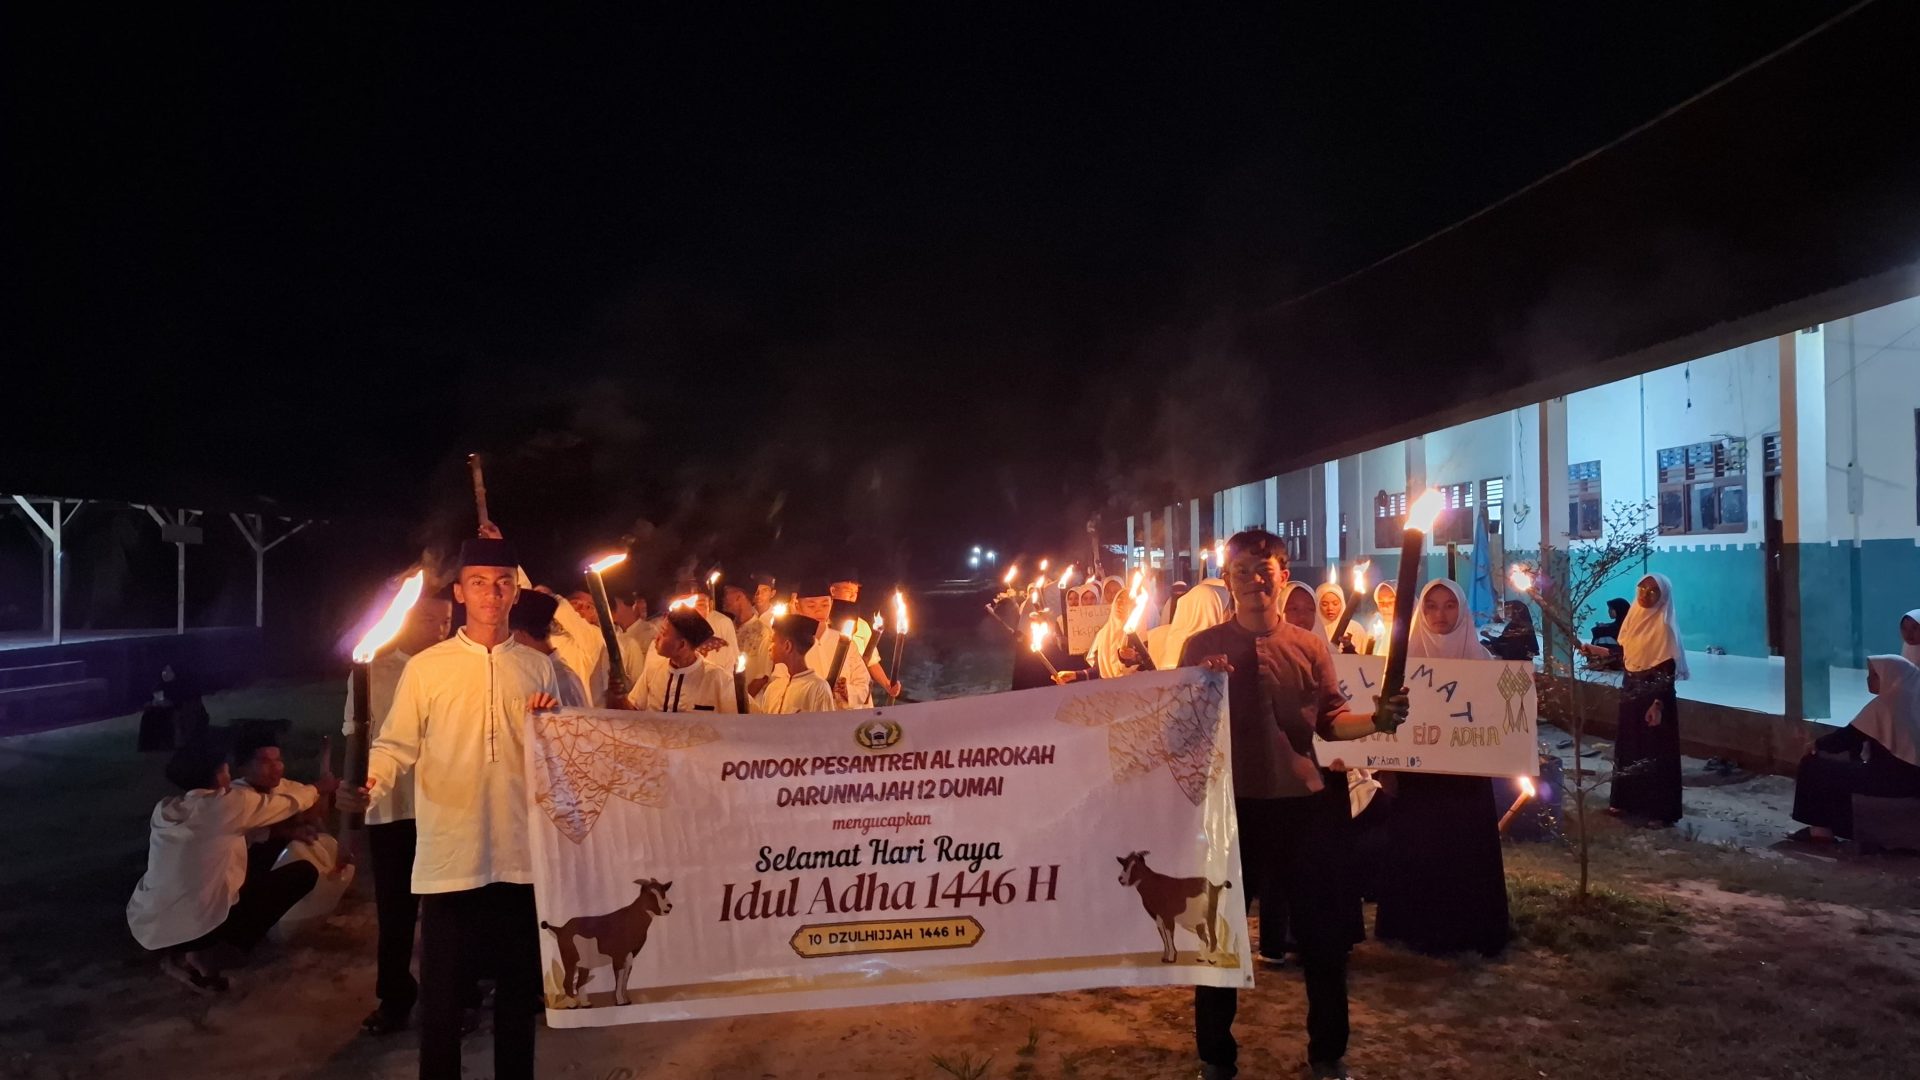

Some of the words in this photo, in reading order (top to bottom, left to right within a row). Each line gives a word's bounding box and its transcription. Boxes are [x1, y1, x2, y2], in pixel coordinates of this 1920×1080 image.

[721, 758, 809, 781] PONDOK
[811, 751, 928, 775] PESANTREN
[930, 750, 955, 769] AL
[958, 745, 1055, 768] HAROKAH
[776, 780, 914, 808] DARUNNAJAH
[917, 779, 937, 799] 12
[939, 776, 1004, 798] DUMAI
[832, 812, 931, 835] mengucapkan
[755, 844, 862, 872] Selamat
[869, 838, 926, 865] Hari
[933, 835, 1003, 873] Raya
[718, 877, 800, 921] Idul
[805, 872, 917, 915] Adha
[924, 867, 1016, 908] 1446
[1026, 864, 1061, 902] H
[808, 934, 822, 946] 10
[829, 929, 913, 944] DZULHIJJAH
[919, 926, 949, 939] 1446
[955, 925, 965, 936] H
